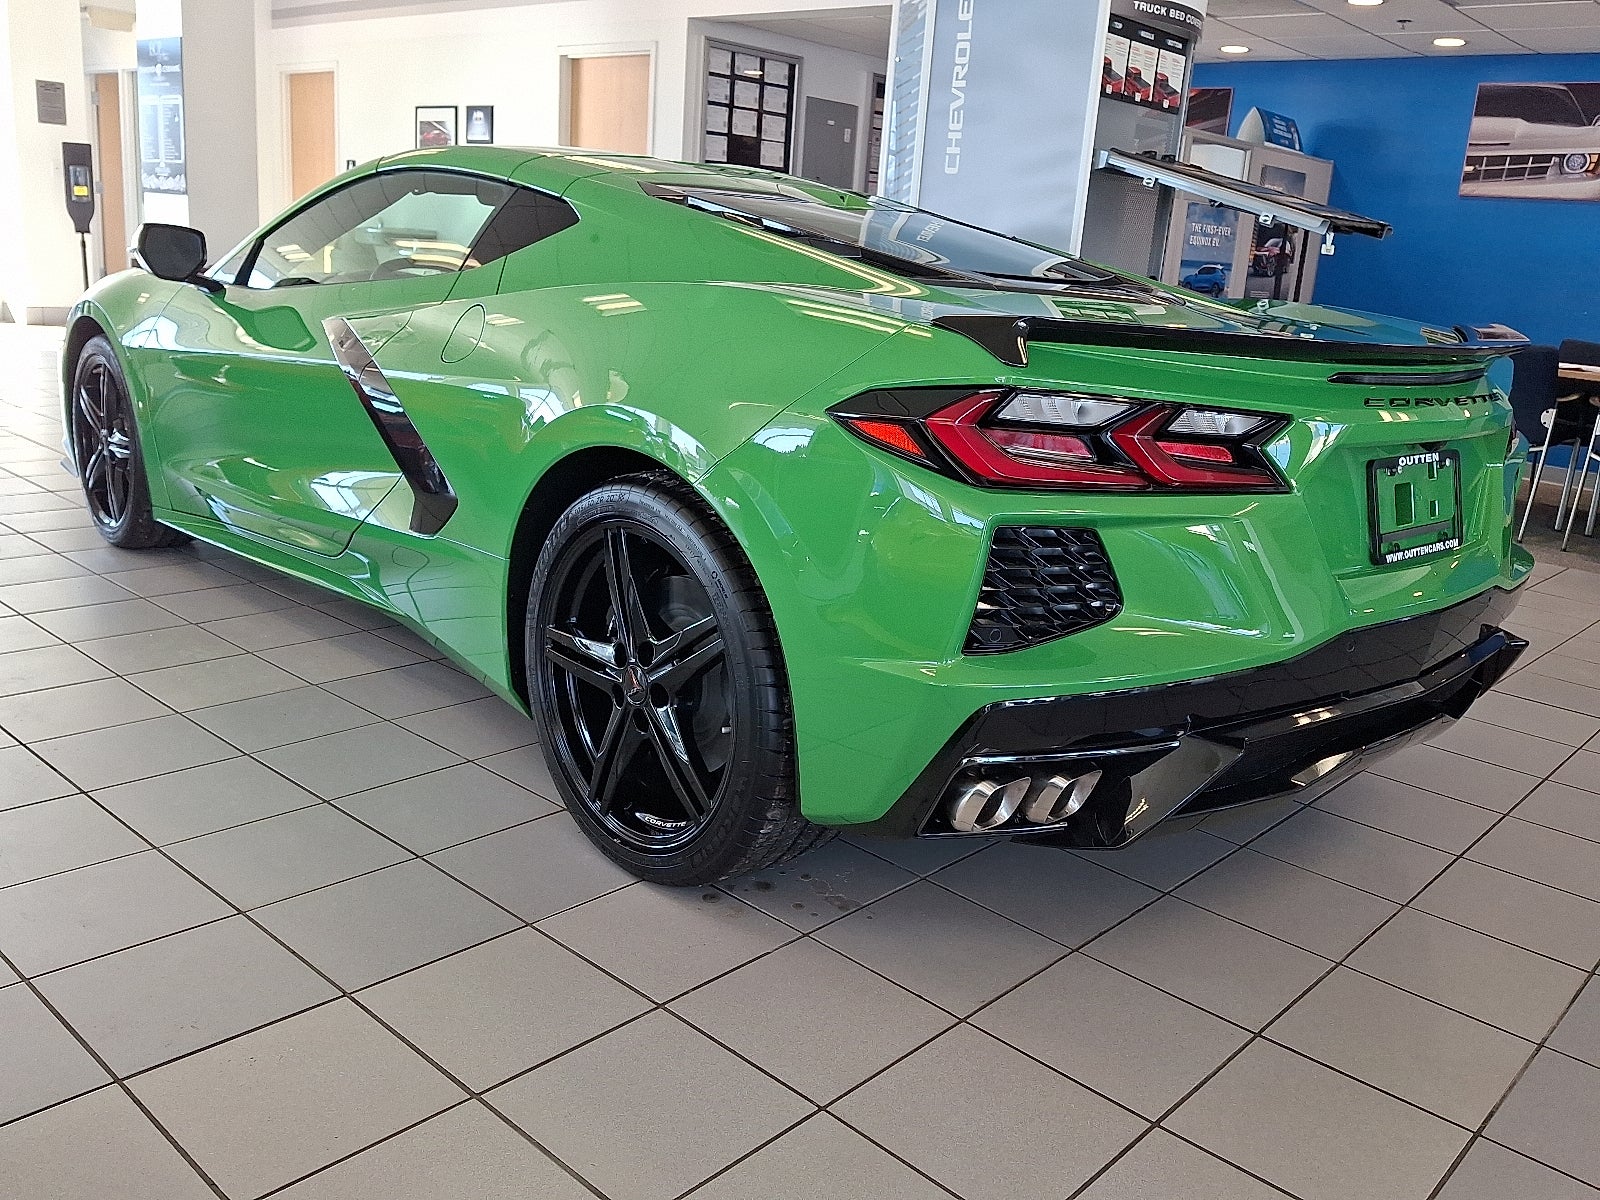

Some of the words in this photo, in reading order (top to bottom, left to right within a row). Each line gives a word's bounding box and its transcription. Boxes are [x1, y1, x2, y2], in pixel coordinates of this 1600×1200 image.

[1133, 1, 1167, 16] TRUCK
[1169, 8, 1185, 21] BED
[1191, 222, 1202, 233] THE
[1202, 223, 1231, 237] FIRST-EVER
[1364, 392, 1501, 407] CORVETTE
[1398, 452, 1439, 467] OUTTEN
[1386, 538, 1459, 563] WWW.OUTTENCARS.COM
[645, 816, 687, 828] CORVETTE
